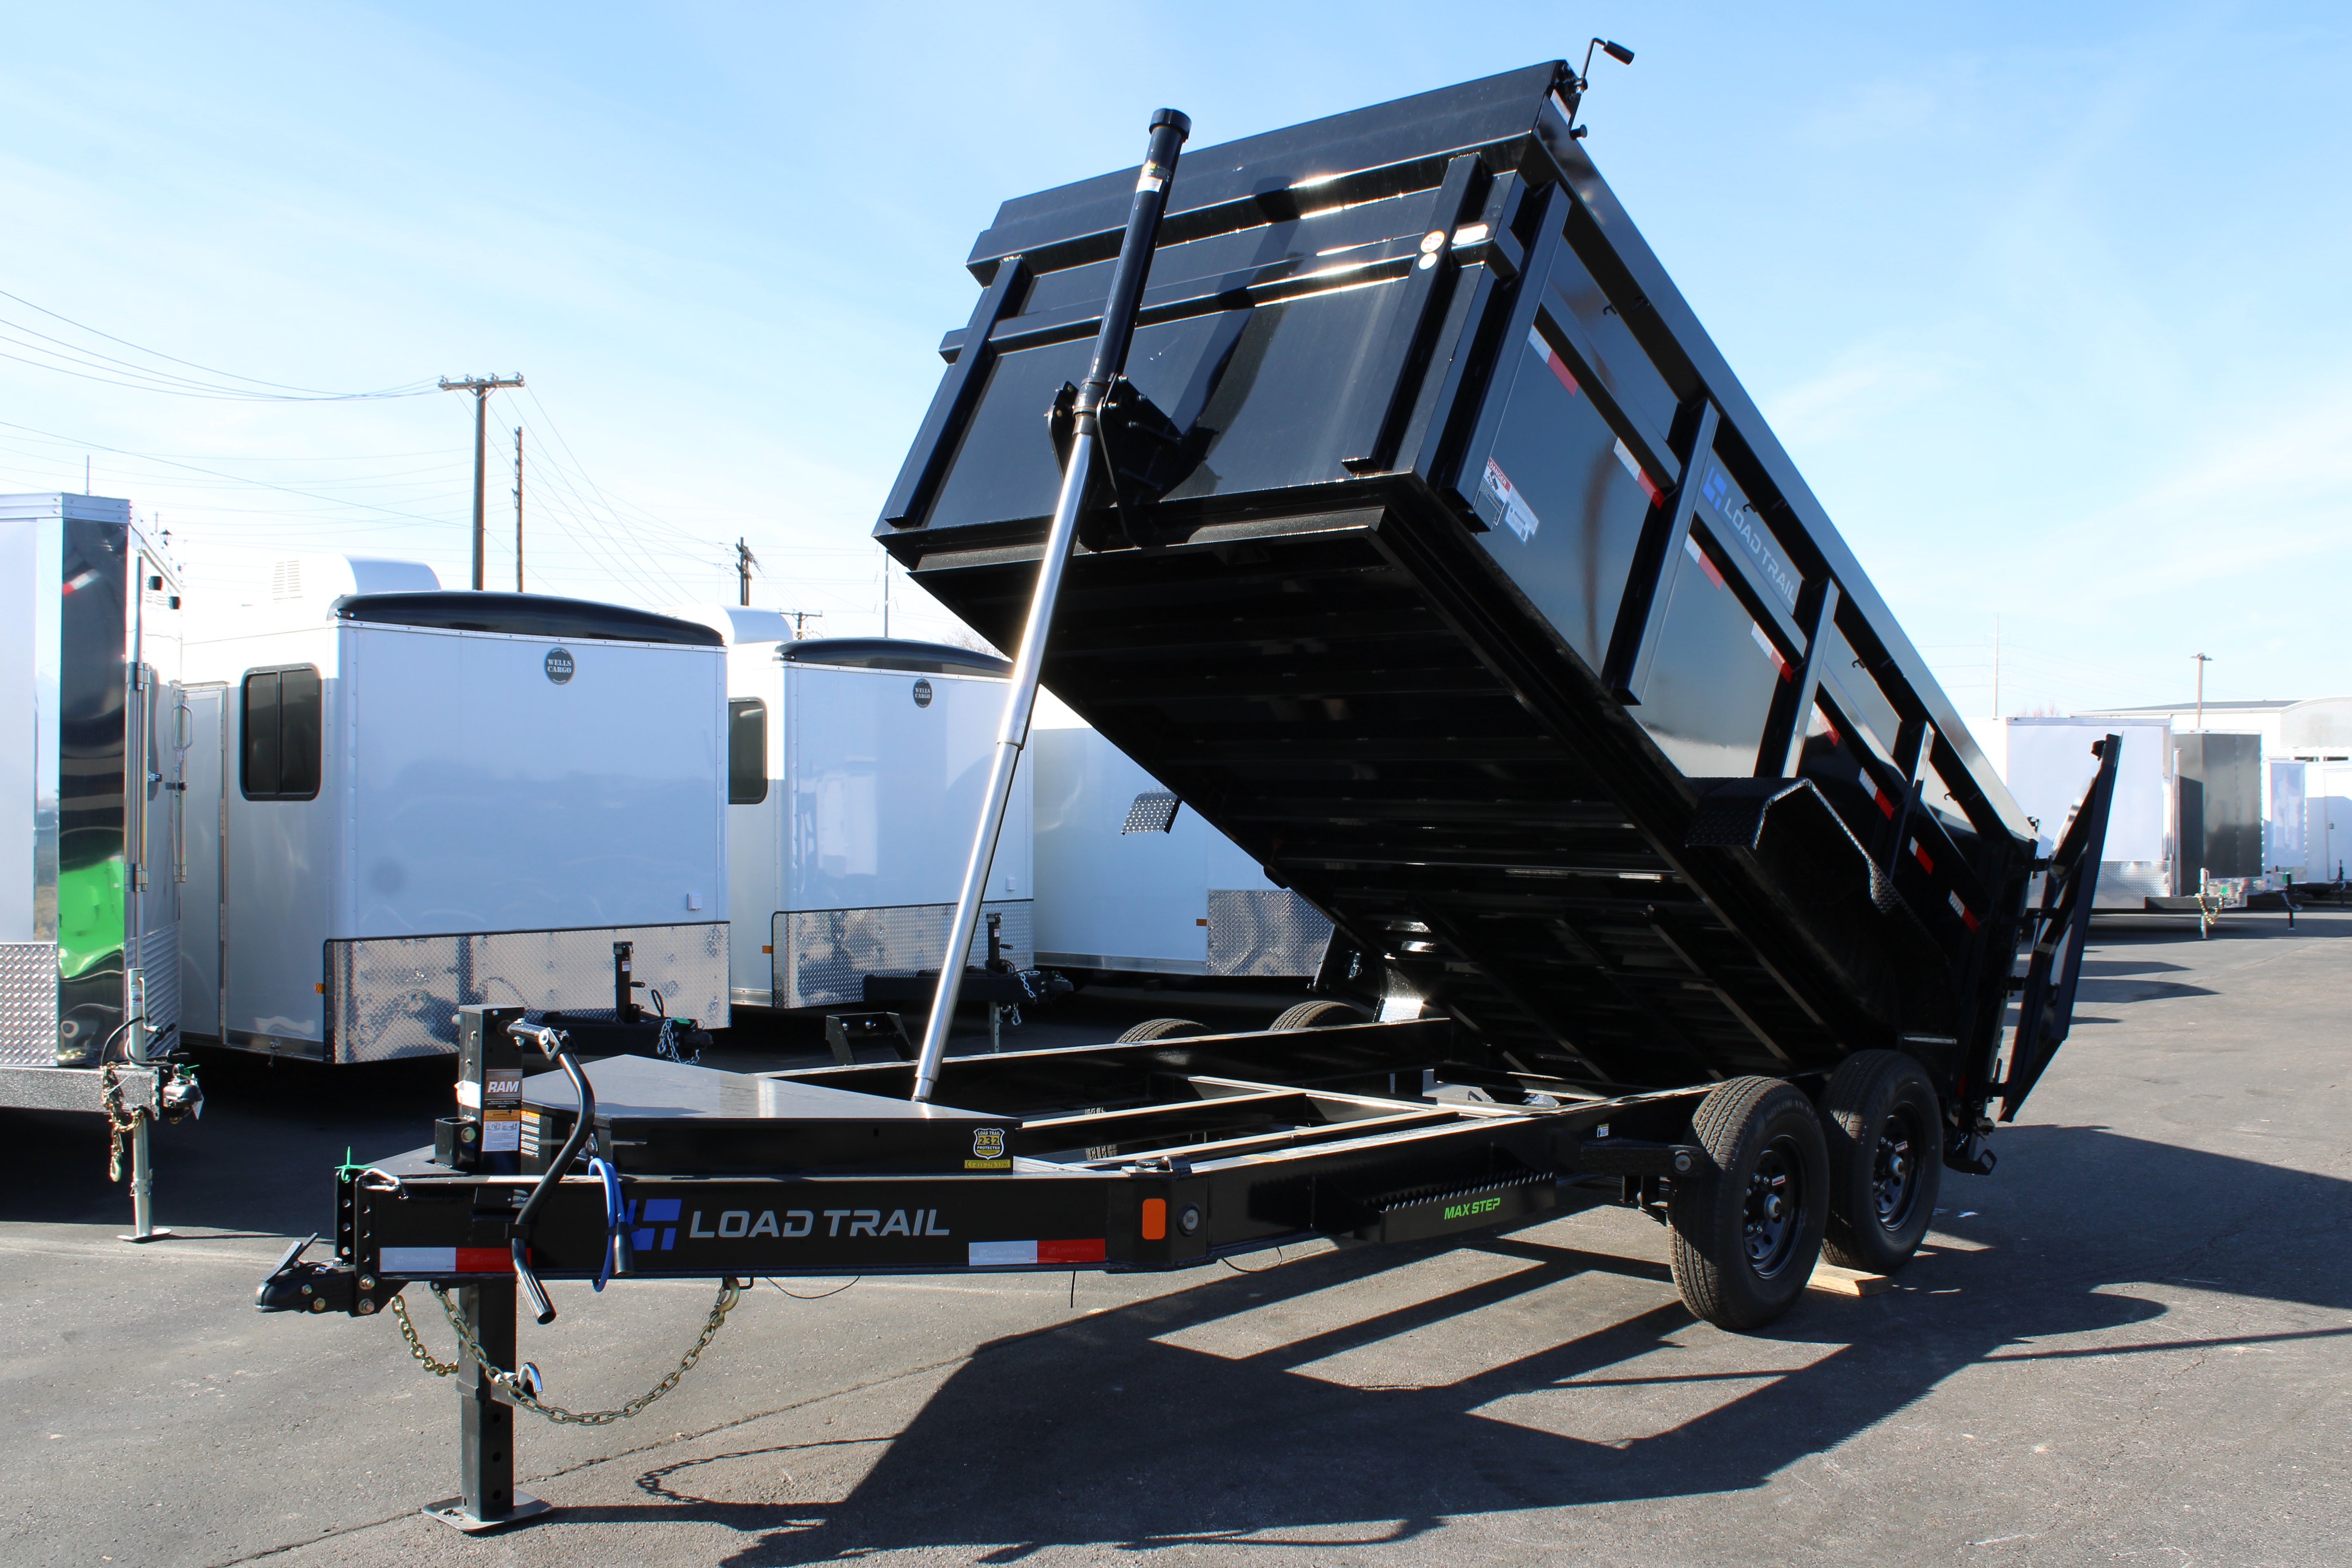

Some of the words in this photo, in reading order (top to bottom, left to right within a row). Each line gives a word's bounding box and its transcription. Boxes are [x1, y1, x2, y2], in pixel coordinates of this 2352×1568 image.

[1489, 461, 1507, 486] DANGER
[1724, 497, 1761, 554] LOAD
[1762, 547, 1794, 605] TRAIL
[488, 1081, 520, 1093] RAM
[979, 1136, 998, 1145] 232
[1444, 1203, 1470, 1220] MAX
[1471, 1197, 1501, 1214] STEP
[689, 1210, 814, 1238] LOAD
[824, 1209, 950, 1237] TRAIL
